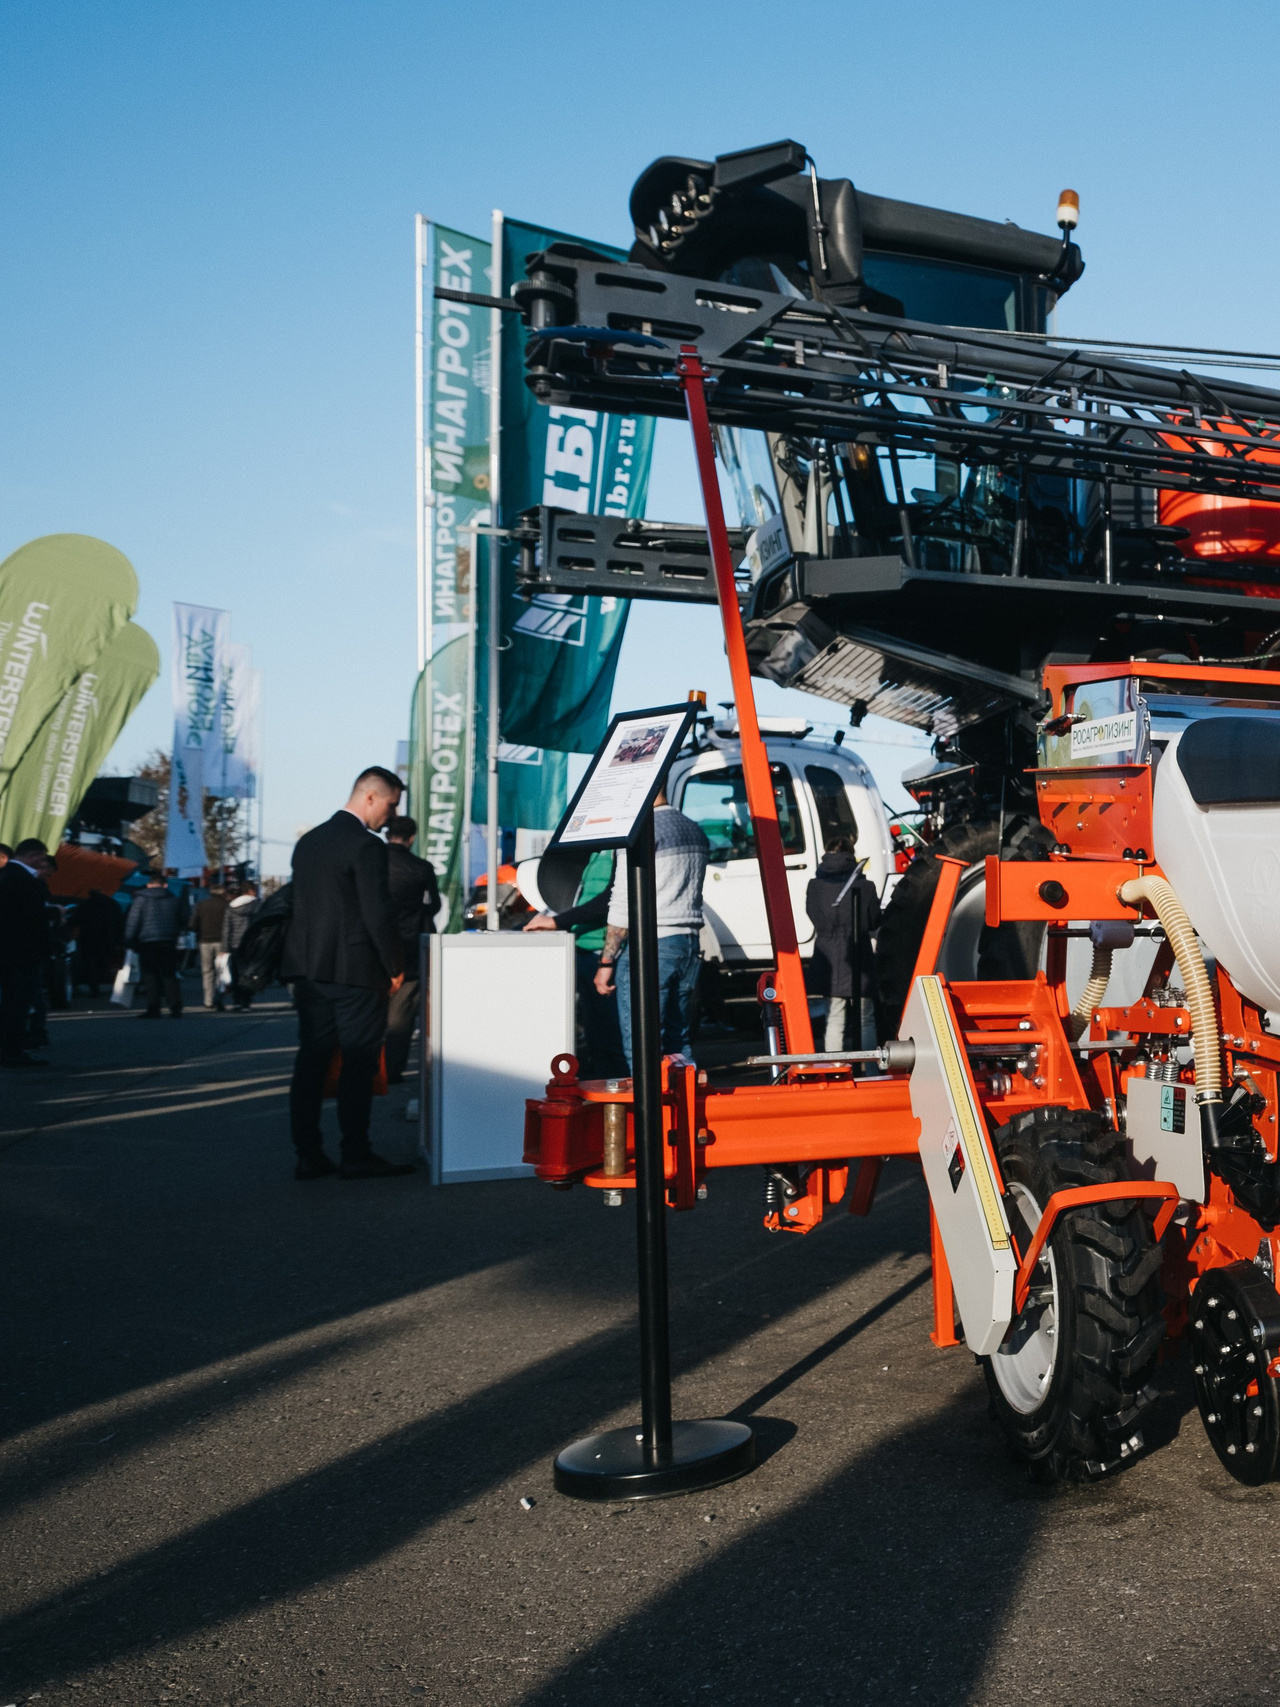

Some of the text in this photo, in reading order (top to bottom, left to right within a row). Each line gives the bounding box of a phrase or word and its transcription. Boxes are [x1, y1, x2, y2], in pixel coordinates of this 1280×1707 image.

[435, 492, 456, 617] ИНАГРОТ
[49, 672, 98, 817] WINTERSTEIGER
[1073, 719, 1134, 746] РОСАГРОЛИЗИНГ
